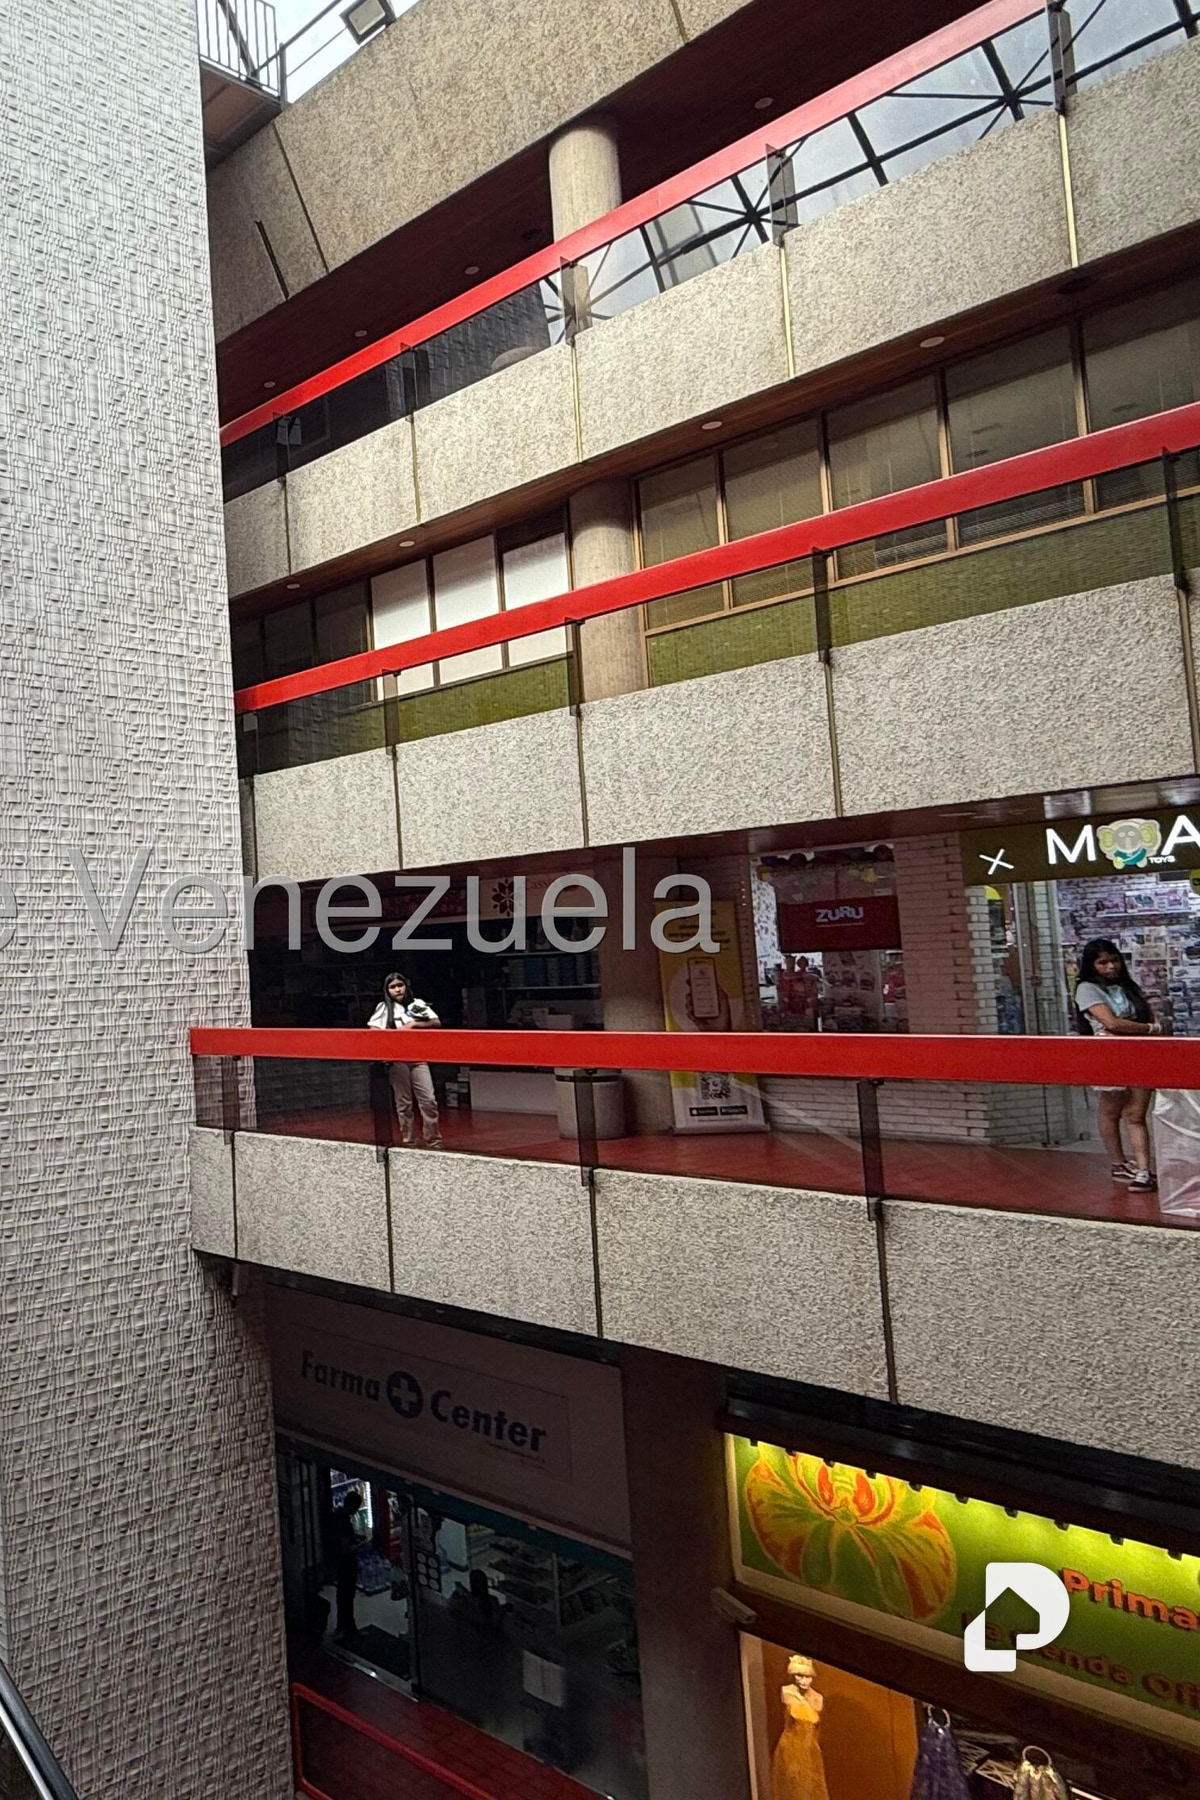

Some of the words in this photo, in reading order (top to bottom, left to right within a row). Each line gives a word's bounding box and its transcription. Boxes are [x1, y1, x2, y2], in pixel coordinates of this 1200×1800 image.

[1148, 855, 1176, 864] TOYS
[815, 906, 865, 922] ZURU
[301, 1349, 380, 1402] Farma
[429, 1389, 547, 1451] Center
